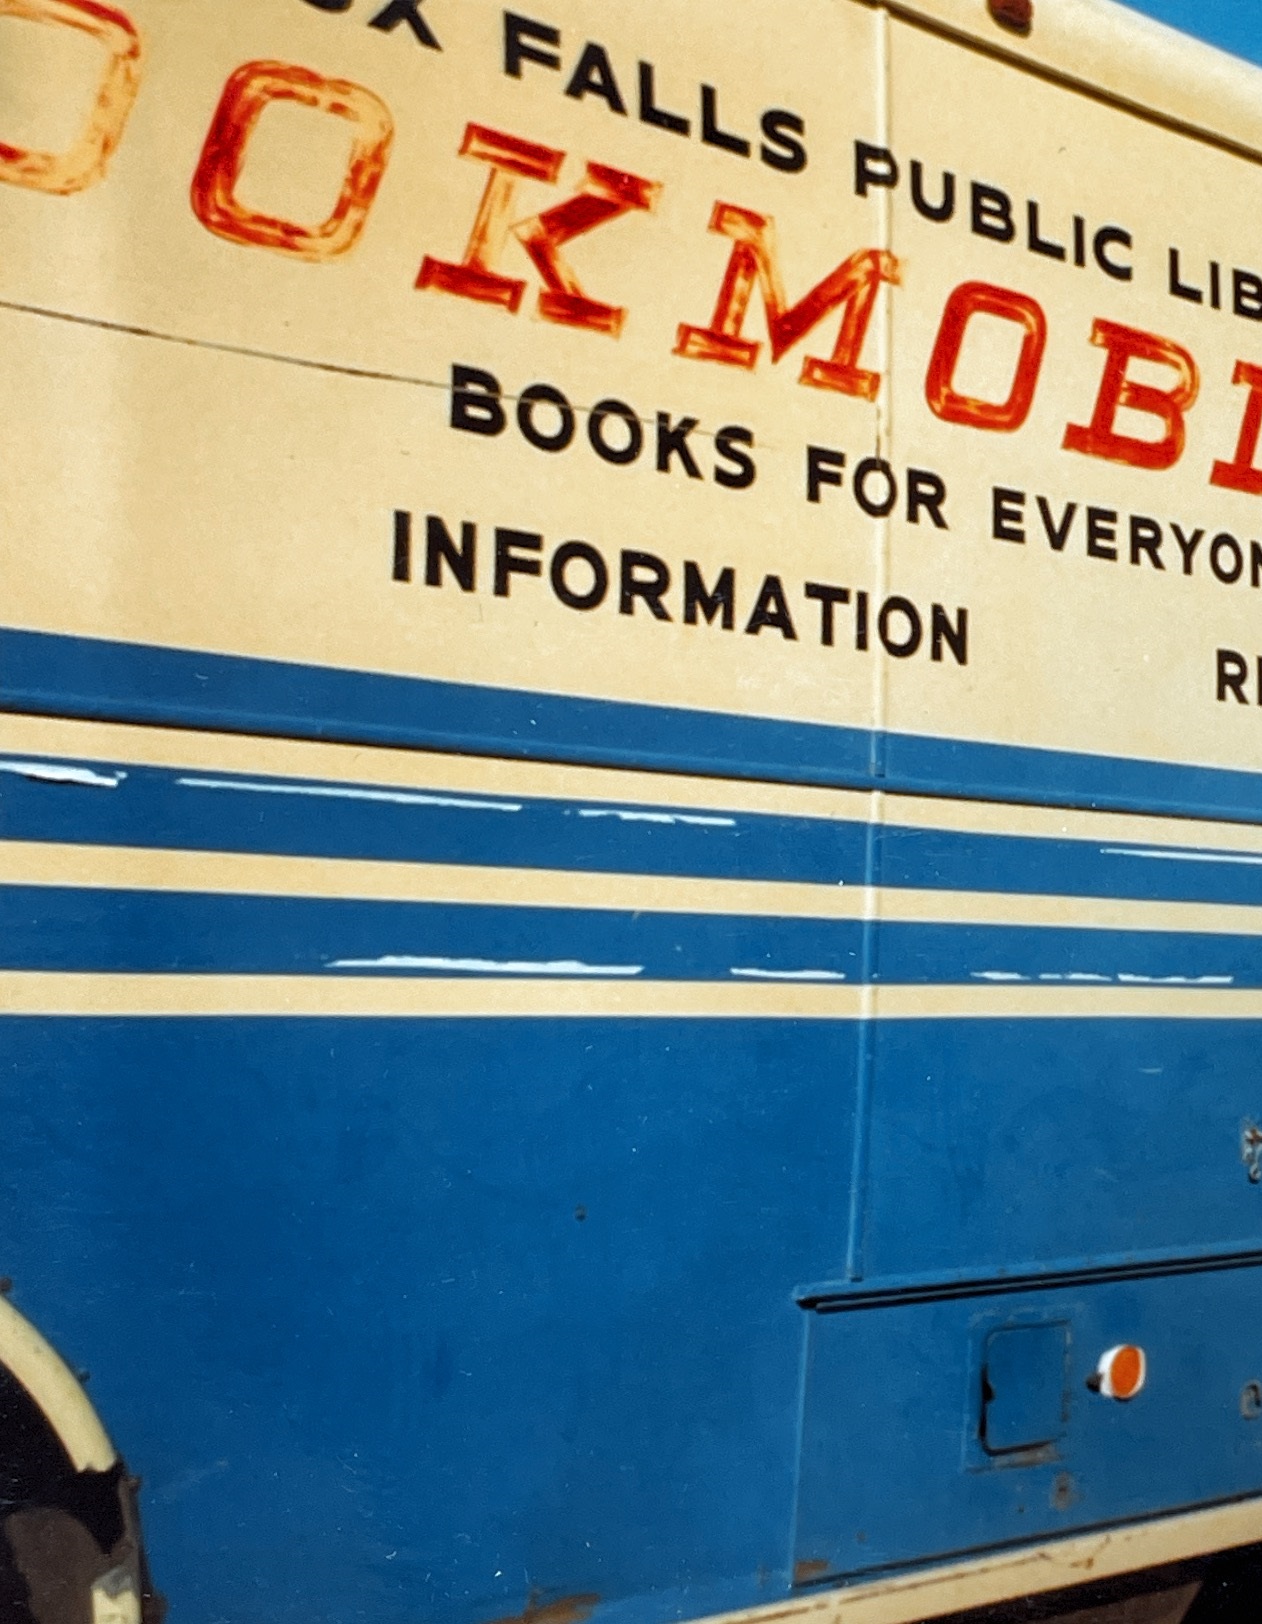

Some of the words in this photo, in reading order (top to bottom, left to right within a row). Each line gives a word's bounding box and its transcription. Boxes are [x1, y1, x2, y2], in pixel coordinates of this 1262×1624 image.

[503, 12, 808, 174] FALLS
[854, 140, 1132, 281] PUBLIC
[450, 364, 757, 490] BOOKS
[807, 445, 948, 529] FOR
[392, 510, 967, 666] INFORMATION
